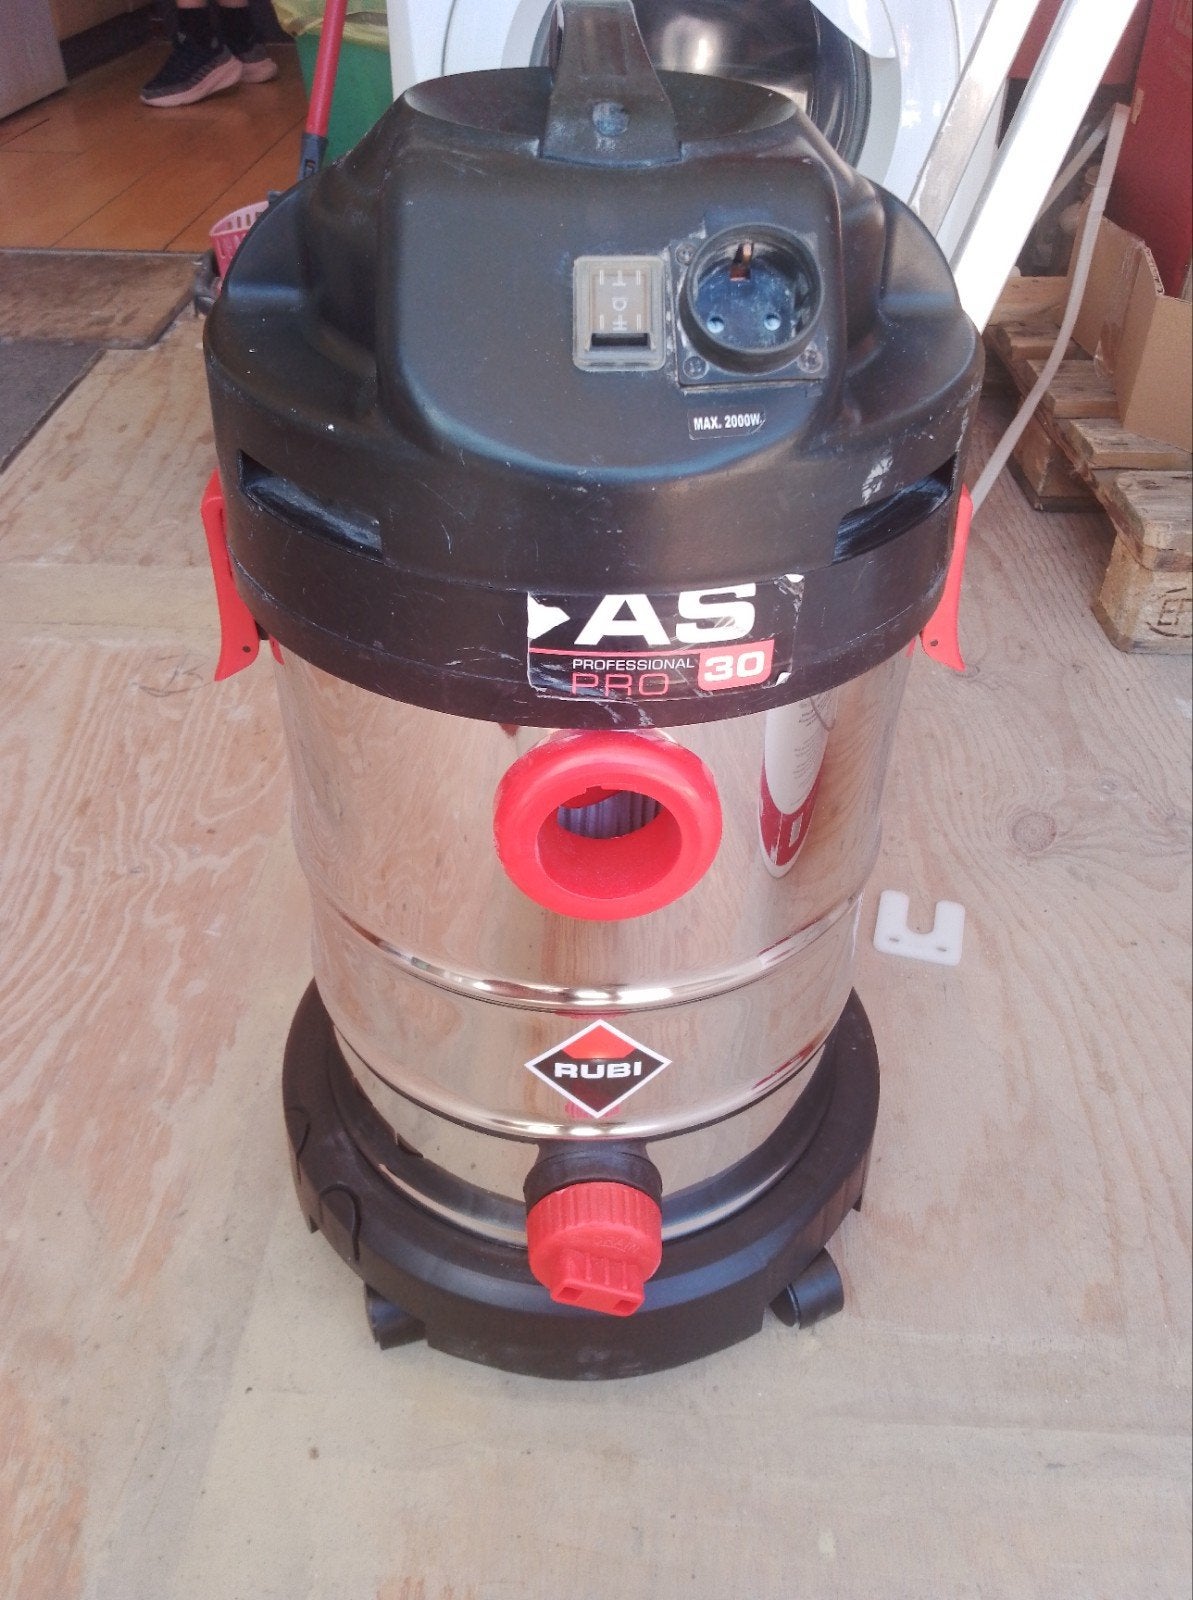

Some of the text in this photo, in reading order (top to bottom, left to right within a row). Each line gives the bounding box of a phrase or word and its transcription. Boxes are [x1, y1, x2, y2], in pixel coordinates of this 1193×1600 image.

[693, 415, 722, 431] MAX.
[574, 582, 756, 646] AS
[572, 657, 695, 671] PROFESSIONAL
[704, 650, 766, 682] 30
[571, 672, 670, 696] PRO
[554, 1061, 642, 1079] RUBI
